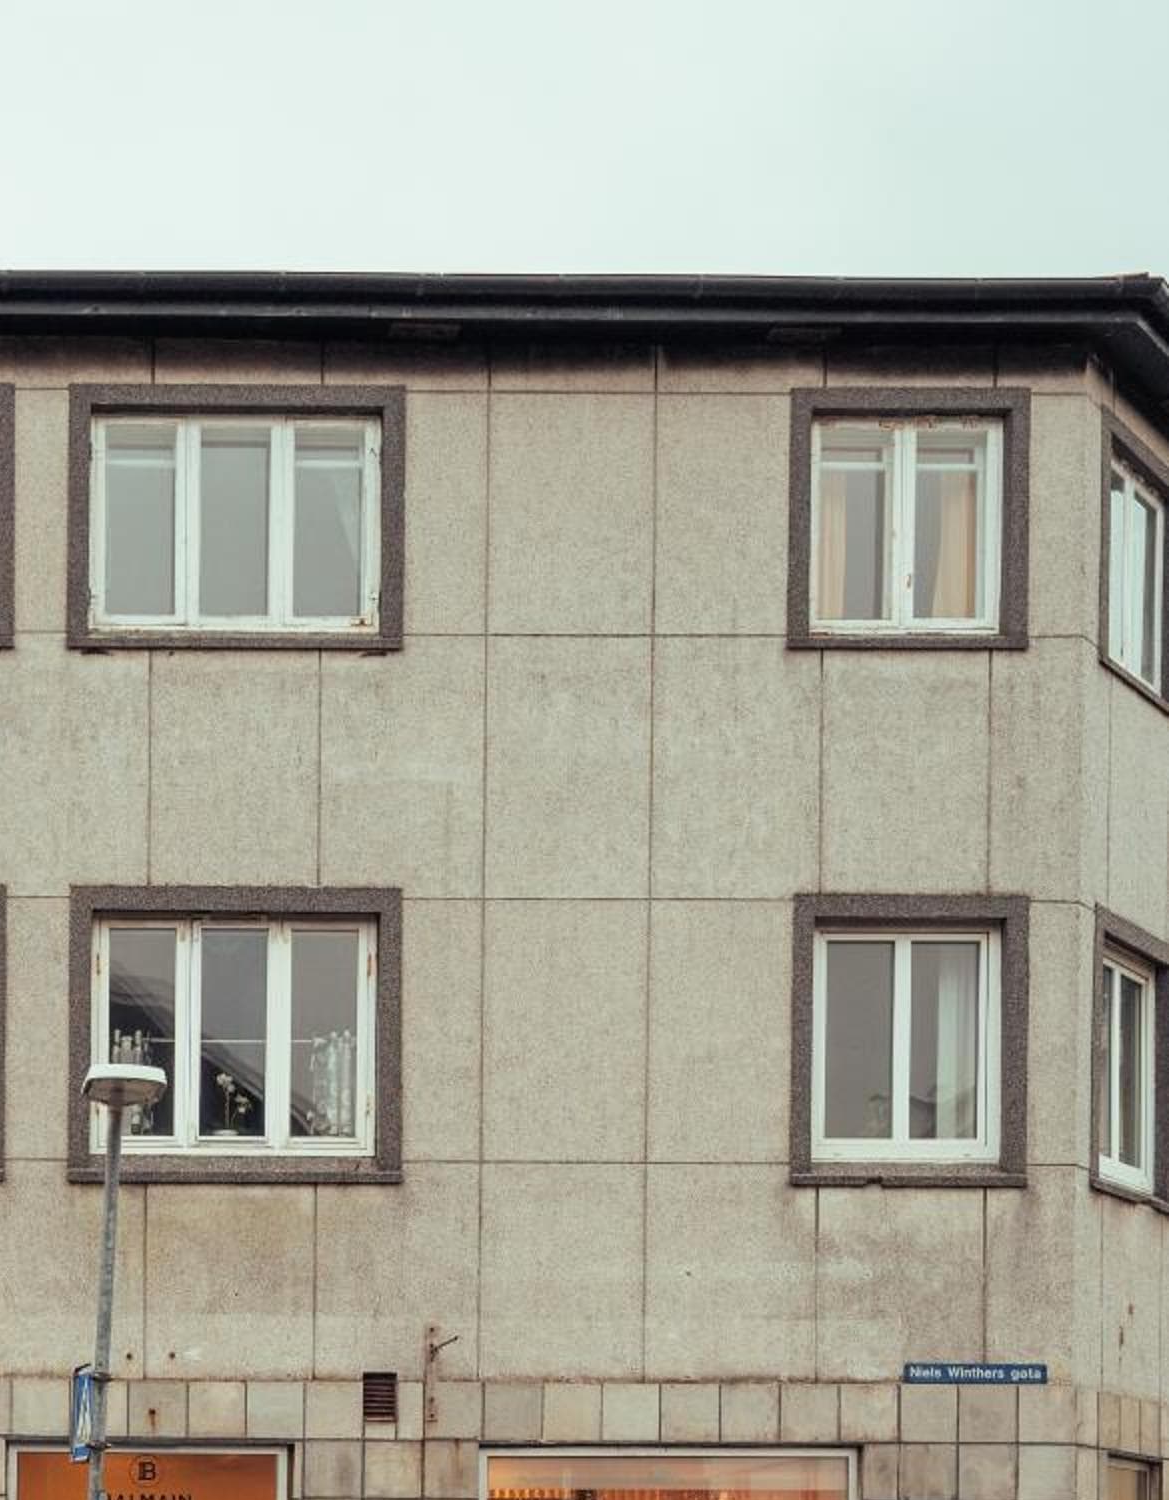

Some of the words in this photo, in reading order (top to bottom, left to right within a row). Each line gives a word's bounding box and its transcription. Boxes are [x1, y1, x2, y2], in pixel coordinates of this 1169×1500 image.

[910, 1365, 942, 1377] Niels
[947, 1366, 1004, 1379] Winthers
[1010, 1367, 1042, 1381] gata
